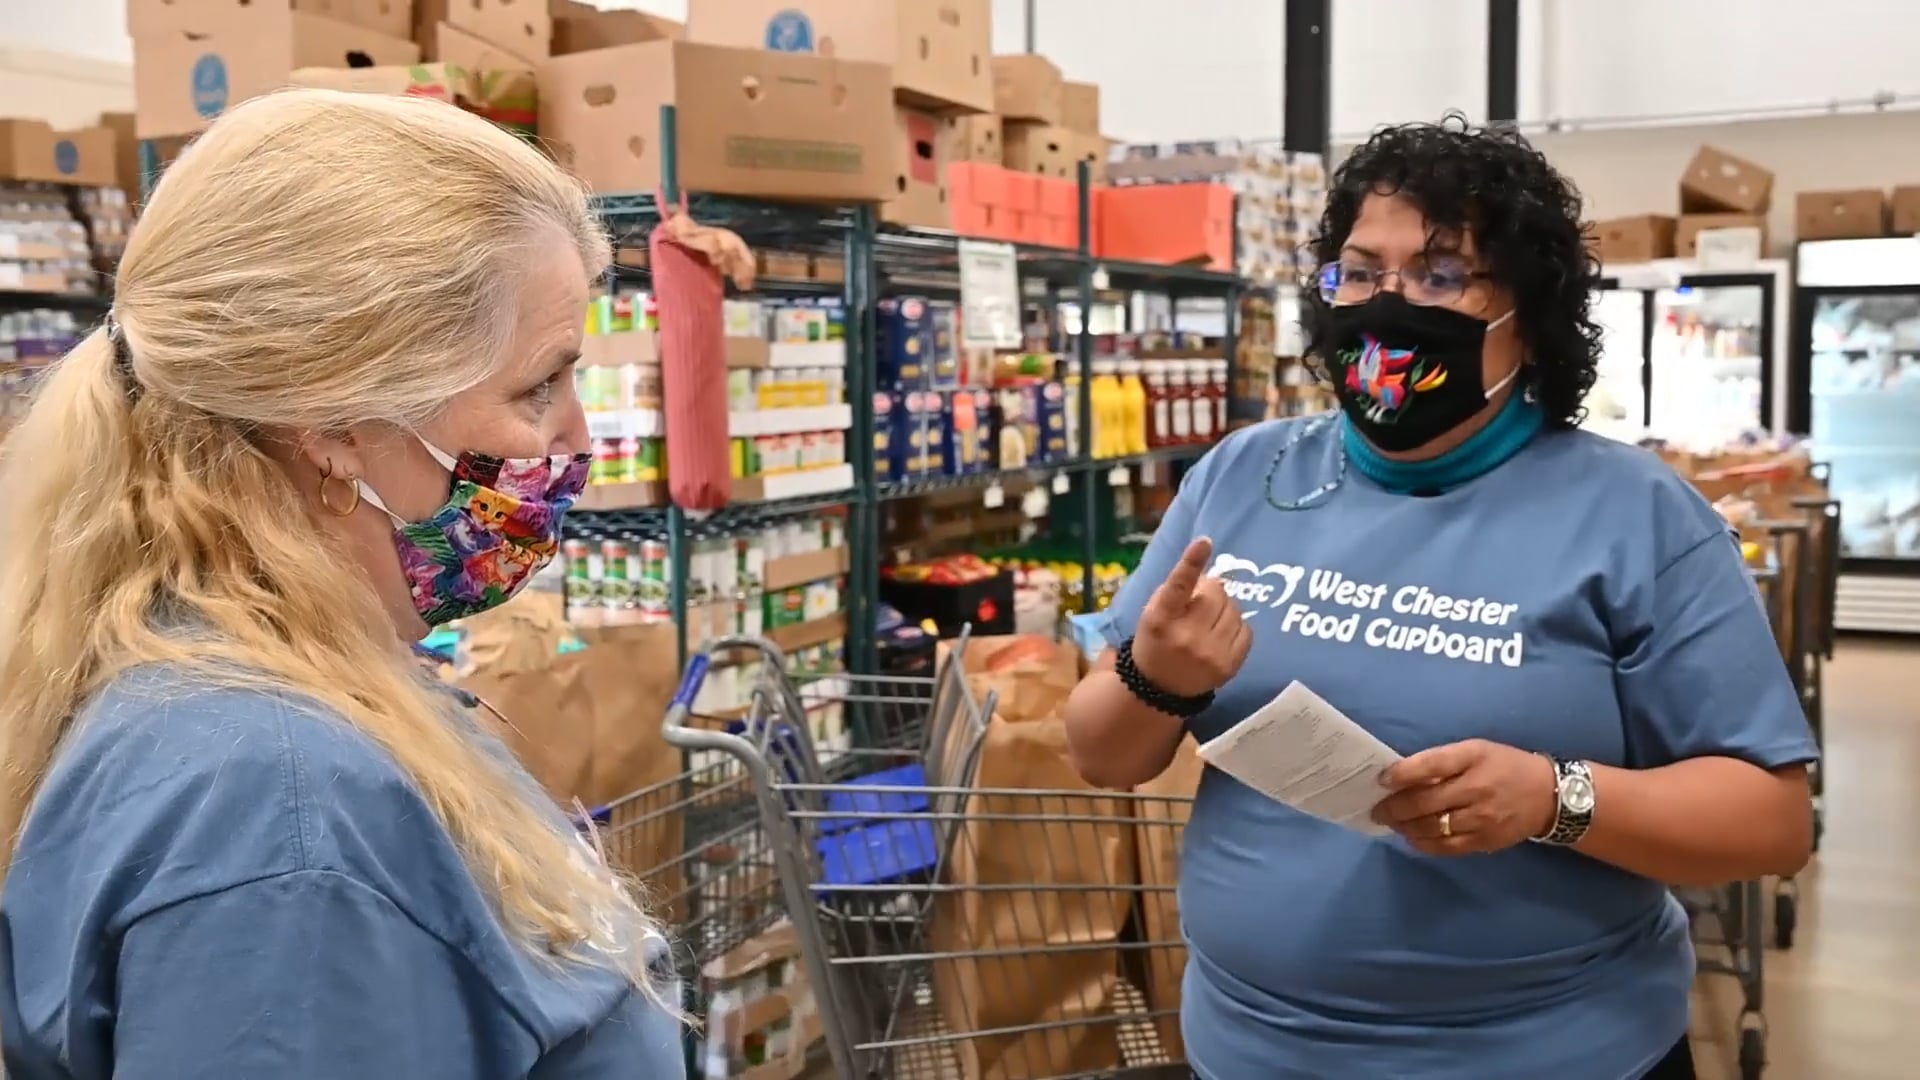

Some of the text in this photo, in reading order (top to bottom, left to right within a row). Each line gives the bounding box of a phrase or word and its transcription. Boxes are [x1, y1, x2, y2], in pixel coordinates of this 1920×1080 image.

[1308, 568, 1519, 626] West Chester
[1281, 603, 1523, 668] Food Cupboard
